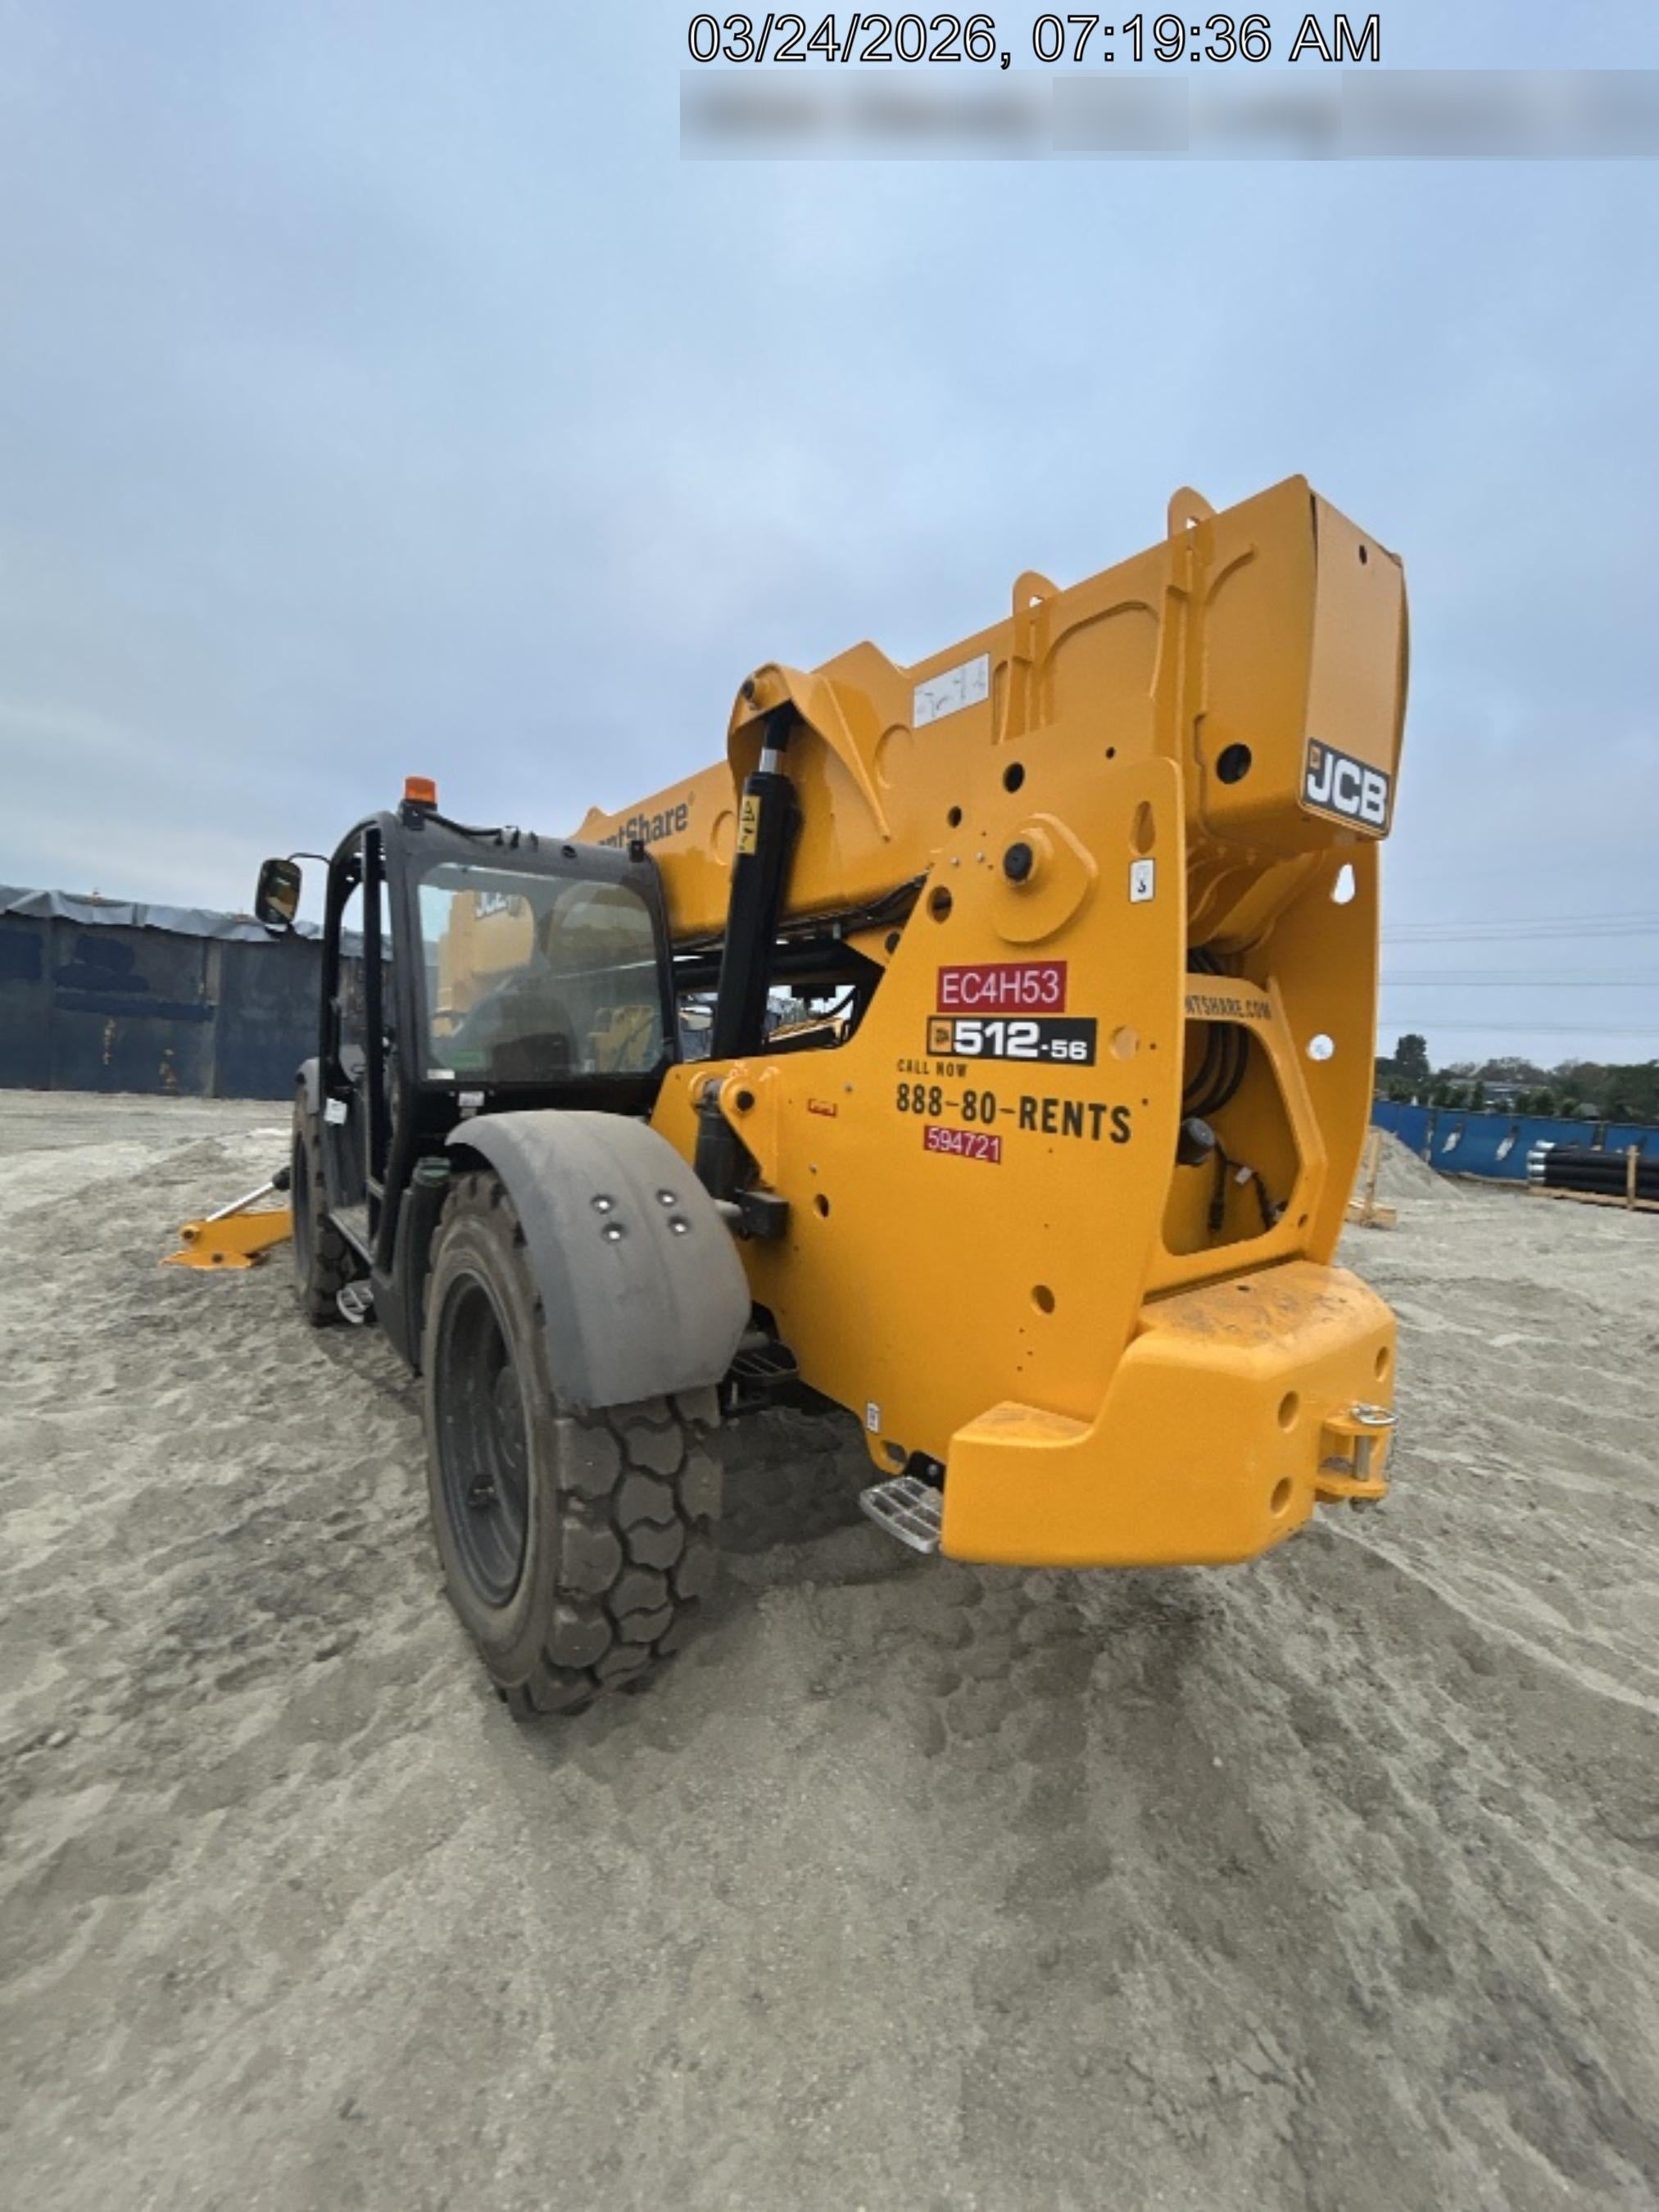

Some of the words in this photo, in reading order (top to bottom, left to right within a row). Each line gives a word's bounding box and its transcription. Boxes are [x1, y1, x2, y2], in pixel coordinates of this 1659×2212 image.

[1308, 752, 1387, 824] JCB
[942, 970, 1059, 1004] EC4H53
[897, 1058, 930, 1076] CALL
[936, 1063, 968, 1078] NOW
[896, 1083, 1131, 1144] 888-80-RENTS
[927, 1127, 1000, 1160] 594721
